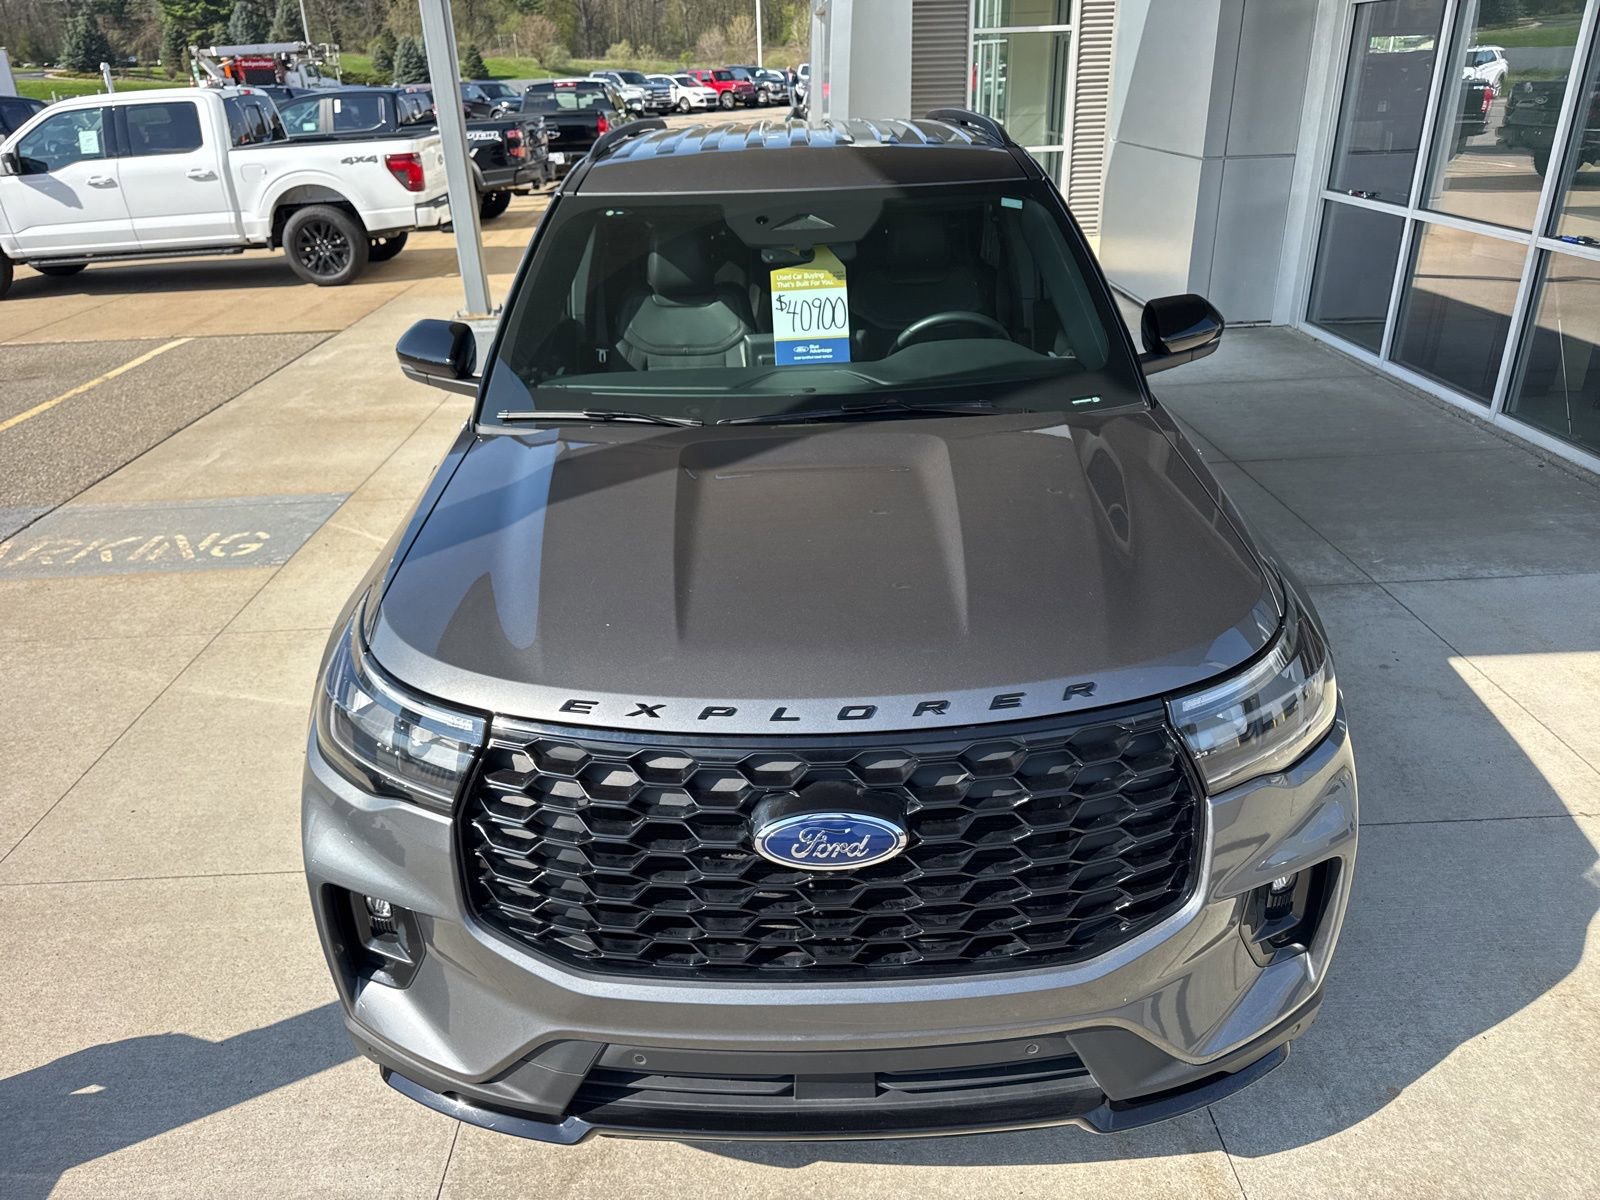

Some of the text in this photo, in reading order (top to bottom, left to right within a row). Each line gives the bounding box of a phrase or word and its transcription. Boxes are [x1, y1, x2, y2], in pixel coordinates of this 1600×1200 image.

[803, 272, 825, 280] Buying
[775, 294, 847, 332] $40900
[0, 532, 271, 567] RKING
[558, 681, 1096, 721] EXPLORER
[790, 826, 871, 859] Ford
